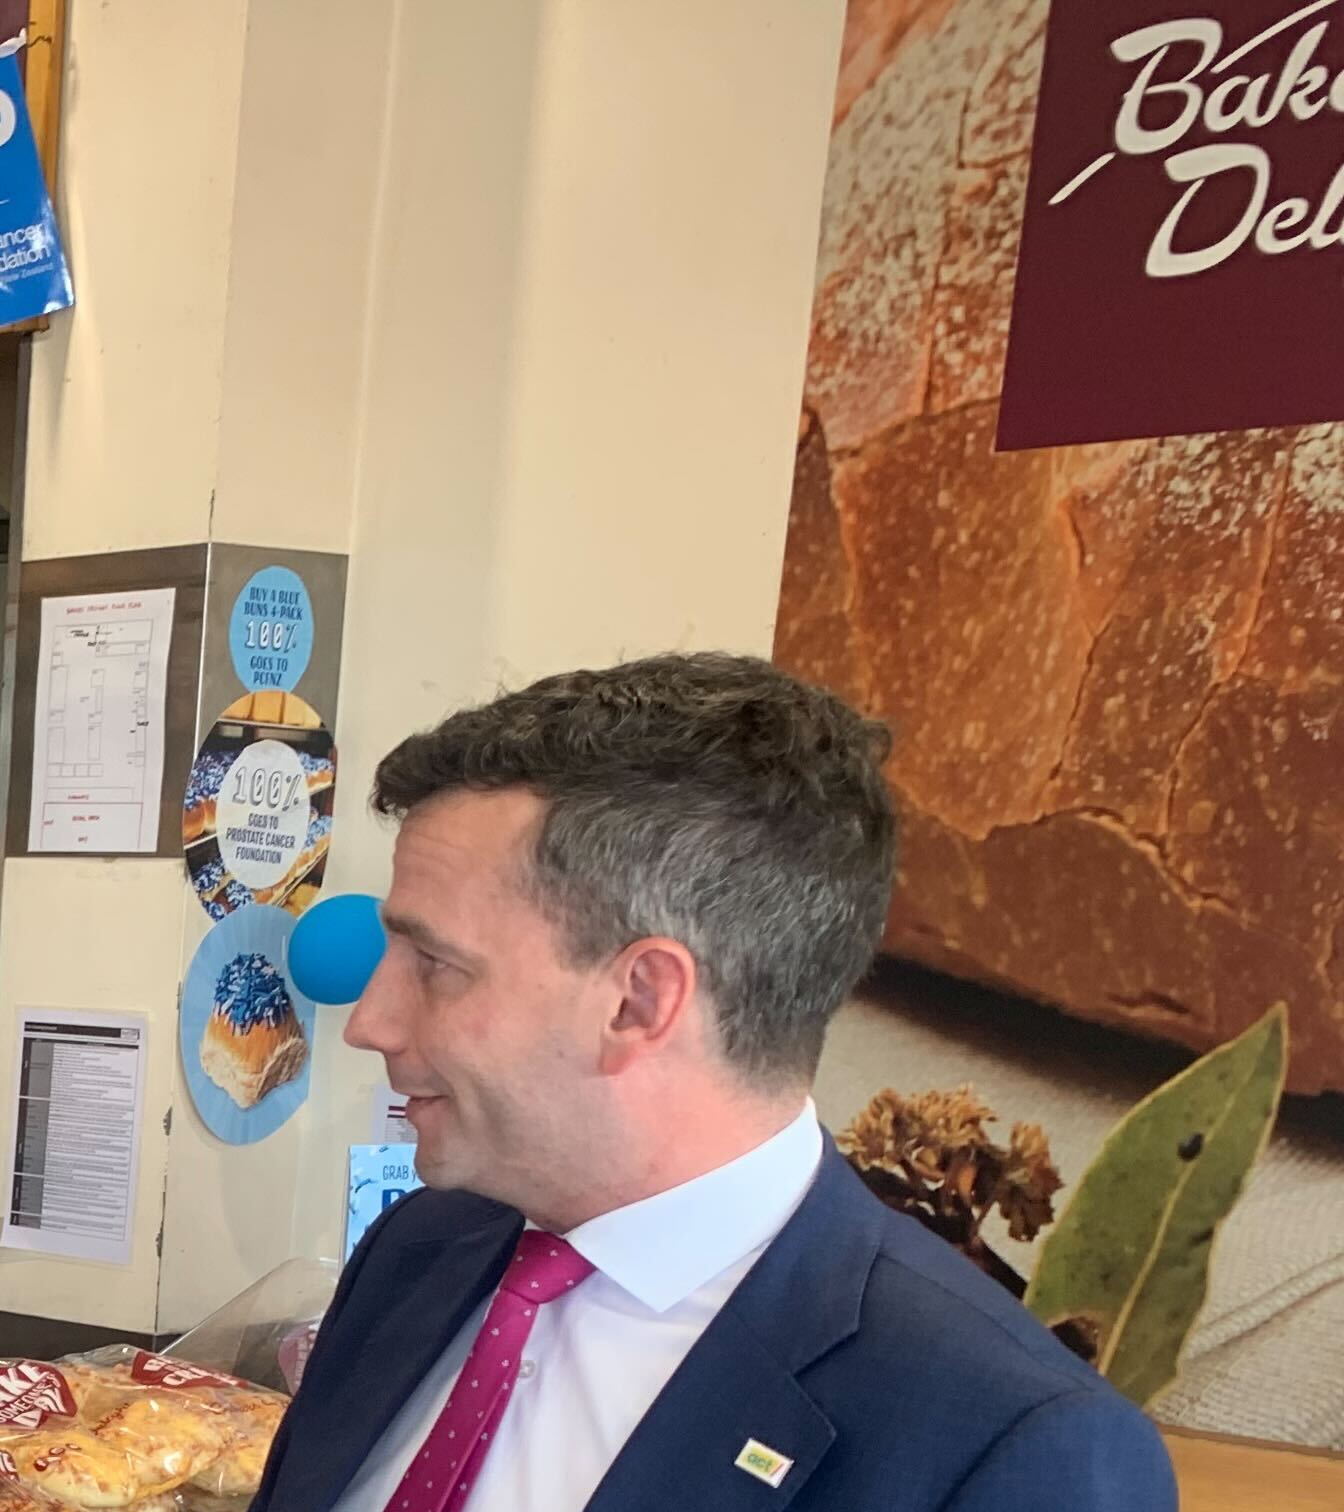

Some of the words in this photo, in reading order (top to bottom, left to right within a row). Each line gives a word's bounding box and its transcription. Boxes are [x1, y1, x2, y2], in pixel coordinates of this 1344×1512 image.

[1145, 143, 1344, 277] Del
[244, 620, 298, 653] 100%
[232, 766, 302, 812] 100%
[226, 827, 264, 846] PROSTATE
[266, 831, 296, 848] CANCER
[382, 1165, 408, 1180] GRAB
